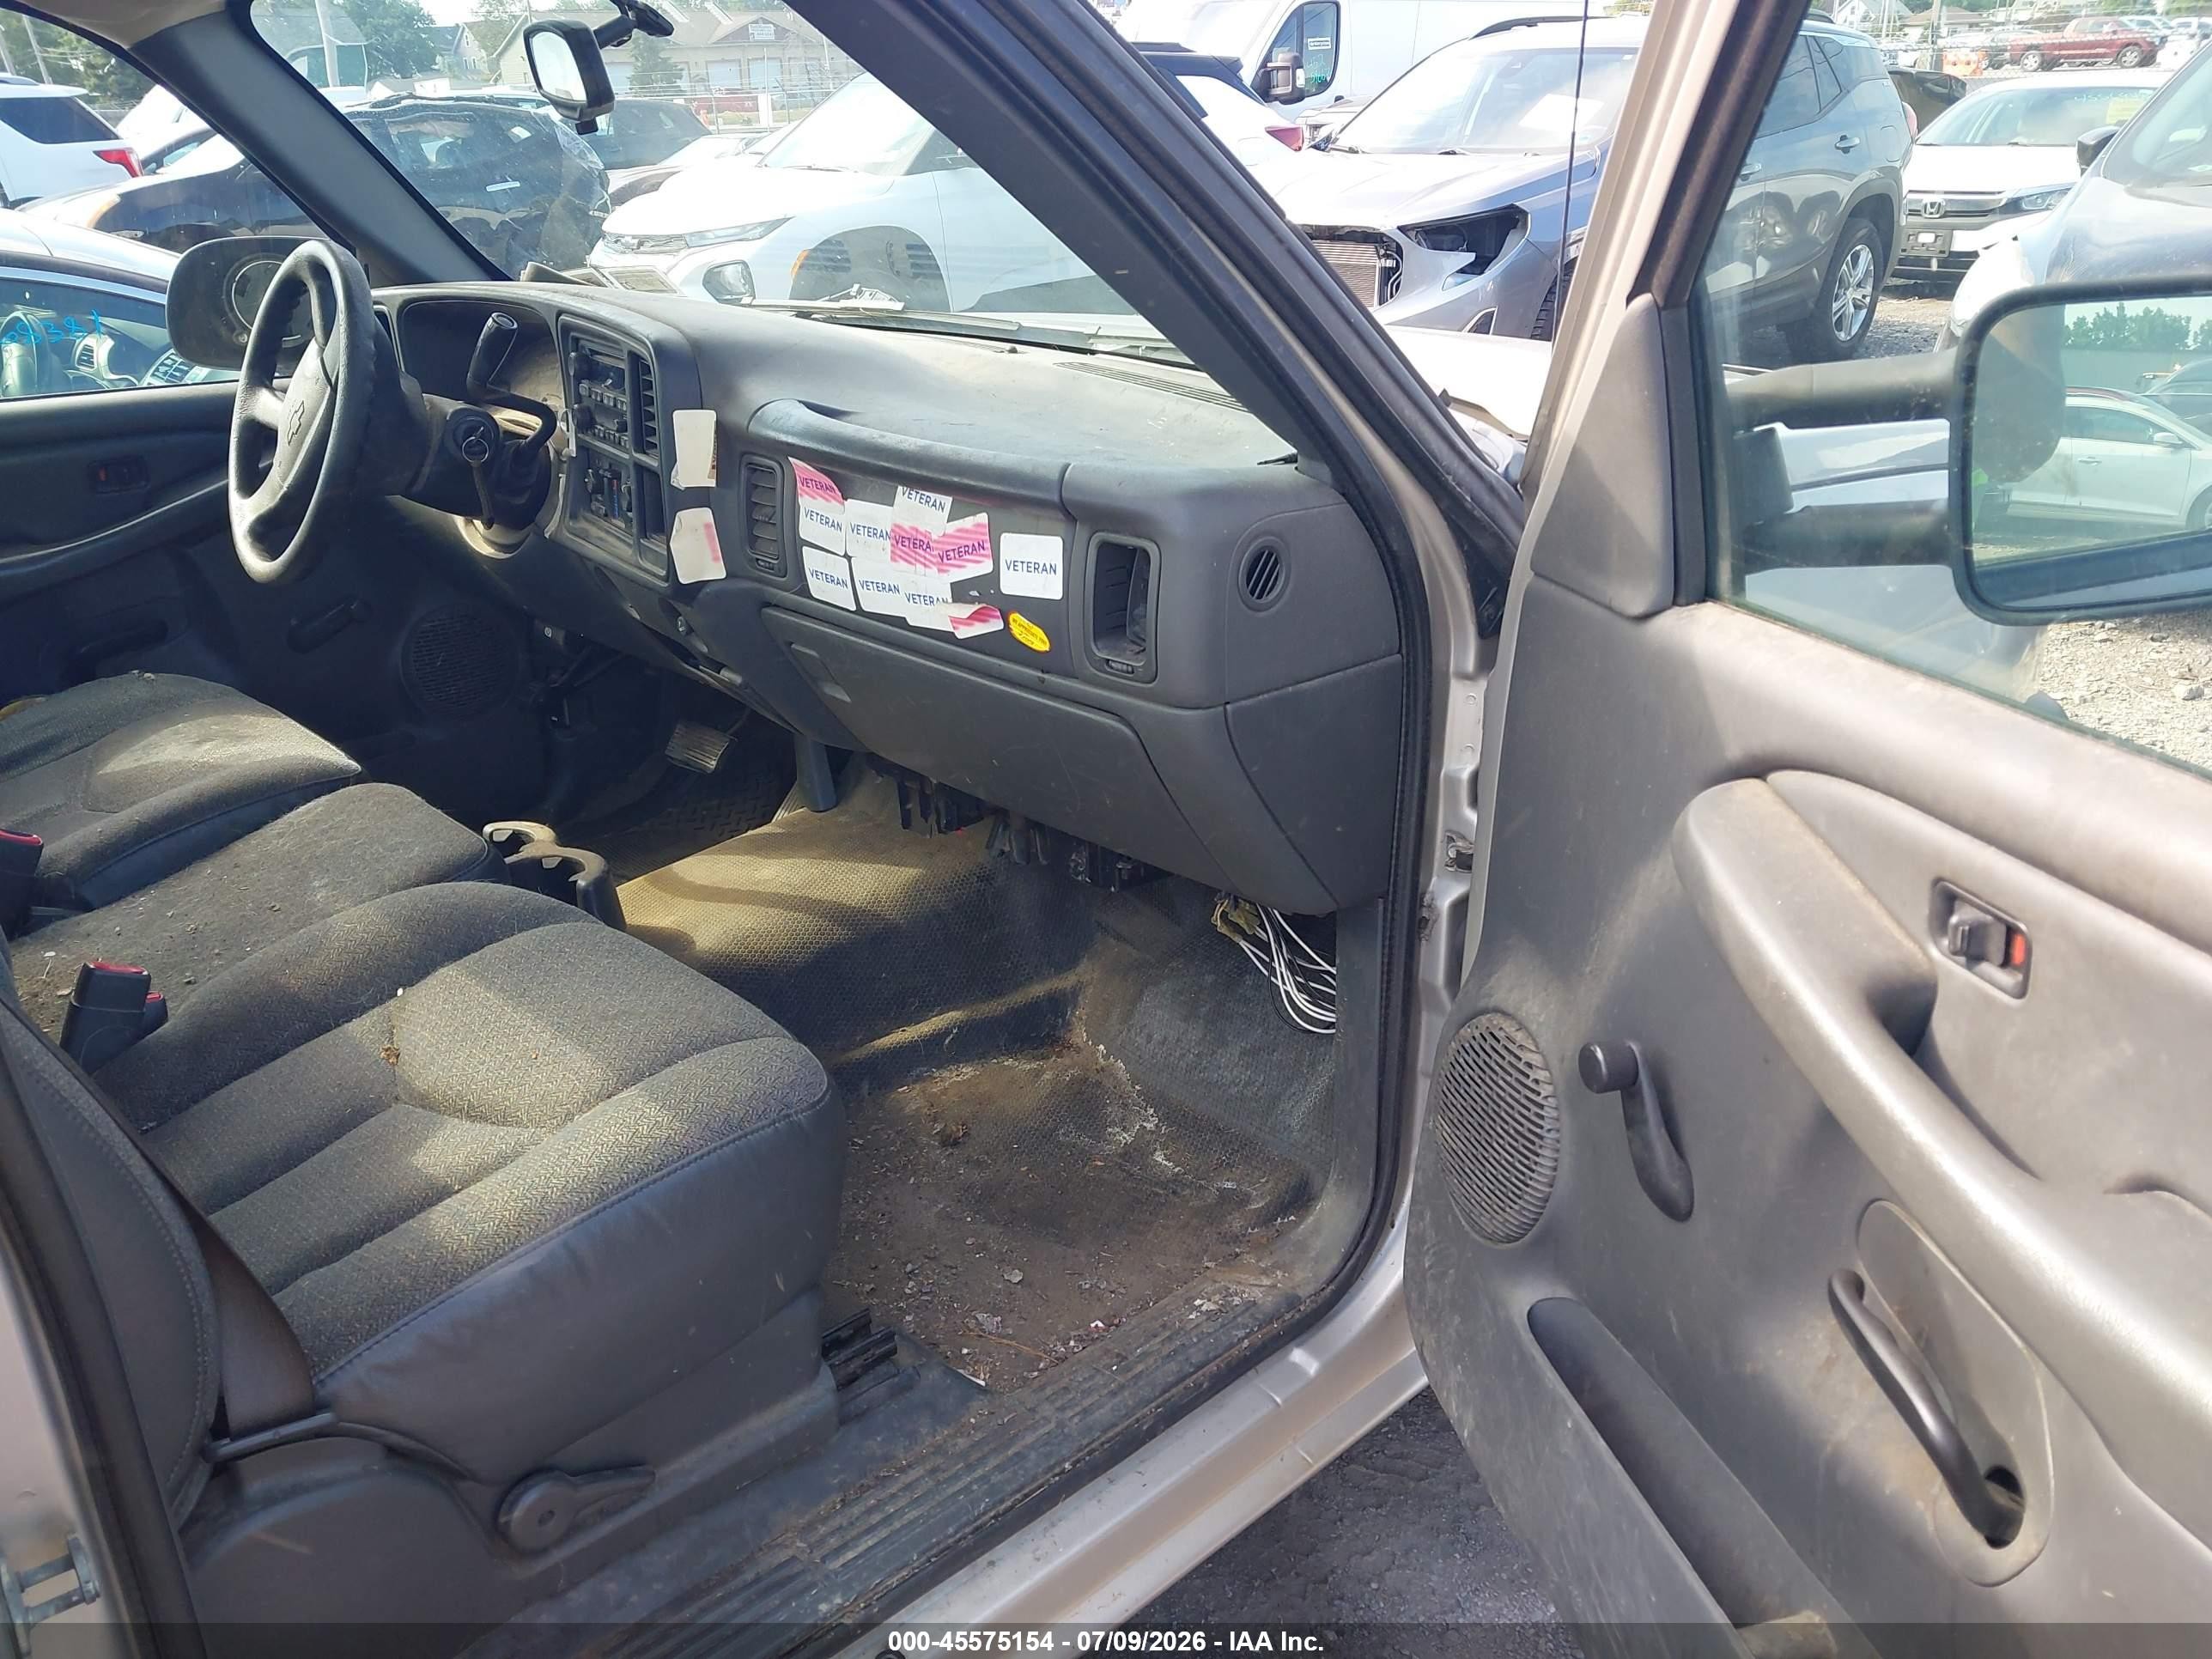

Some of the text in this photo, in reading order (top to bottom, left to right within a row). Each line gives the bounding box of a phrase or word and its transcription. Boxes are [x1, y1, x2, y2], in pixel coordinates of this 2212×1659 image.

[799, 476, 838, 495] VETERAN
[902, 487, 945, 513] VETERAN
[804, 507, 842, 532] VETERAN
[849, 522, 891, 541] VETERAN
[894, 535, 933, 553] VETERA
[938, 540, 986, 563] VETERAN
[1005, 559, 1057, 575] VETERAN
[808, 567, 848, 589] VETERAN
[859, 580, 900, 595] VETERAN
